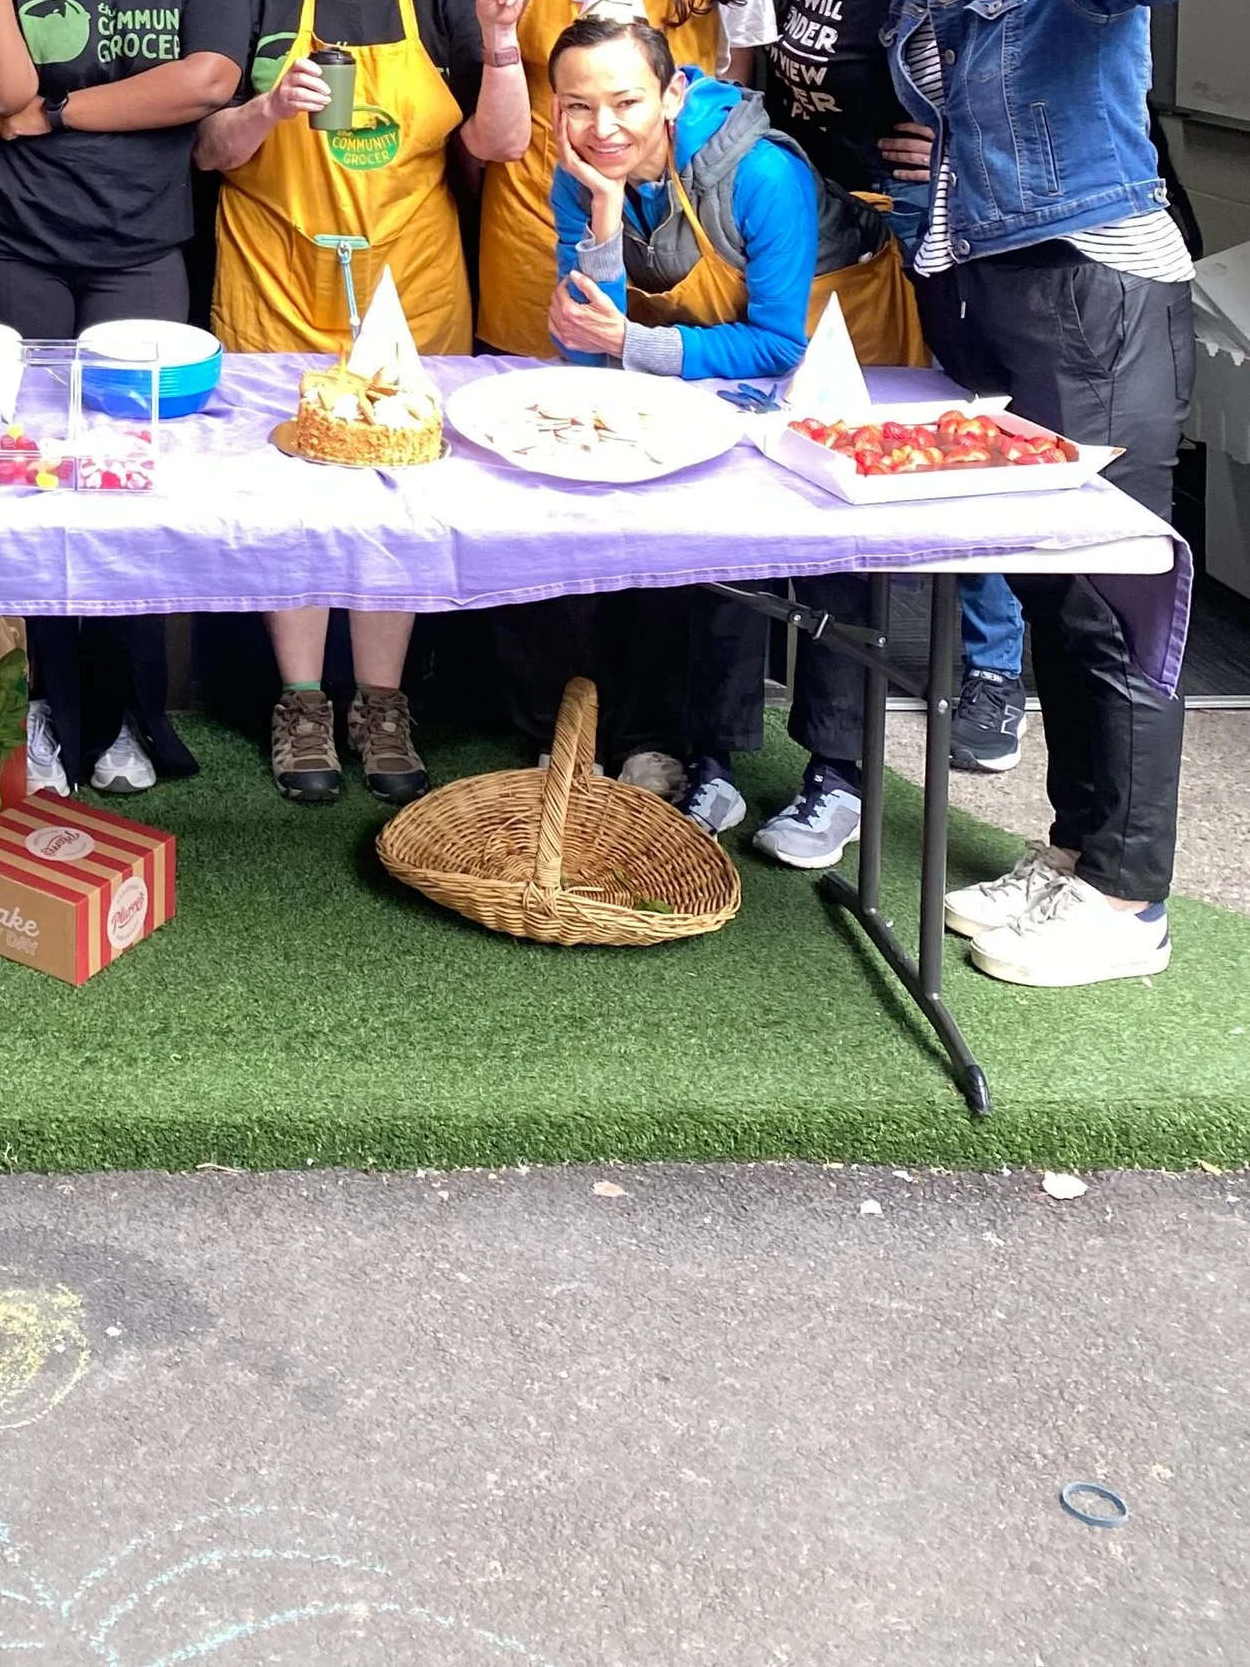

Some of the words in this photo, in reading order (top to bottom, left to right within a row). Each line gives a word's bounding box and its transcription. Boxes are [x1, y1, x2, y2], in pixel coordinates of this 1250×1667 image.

[779, 51, 828, 86] VIEW
[332, 131, 398, 151] COMMUNITY
[343, 150, 390, 165] GROCER
